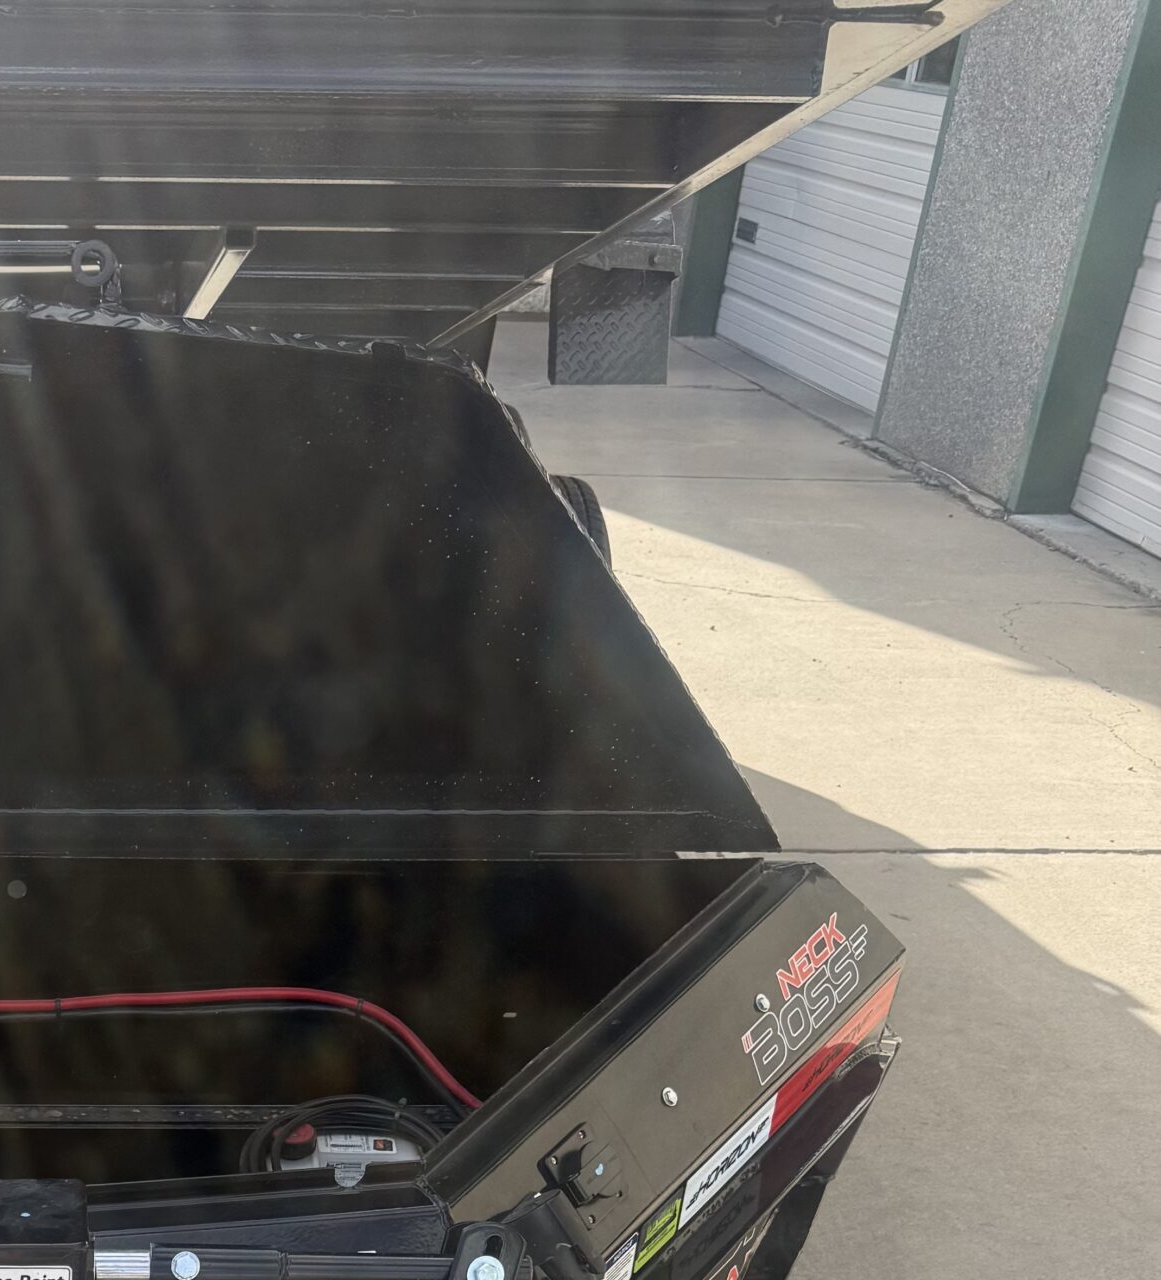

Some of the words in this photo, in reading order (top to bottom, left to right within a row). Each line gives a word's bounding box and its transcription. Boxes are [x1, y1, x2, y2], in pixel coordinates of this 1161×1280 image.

[776, 911, 846, 1001] NECK
[741, 940, 860, 1087] BOSS
[688, 1118, 766, 1205] HORIZON
